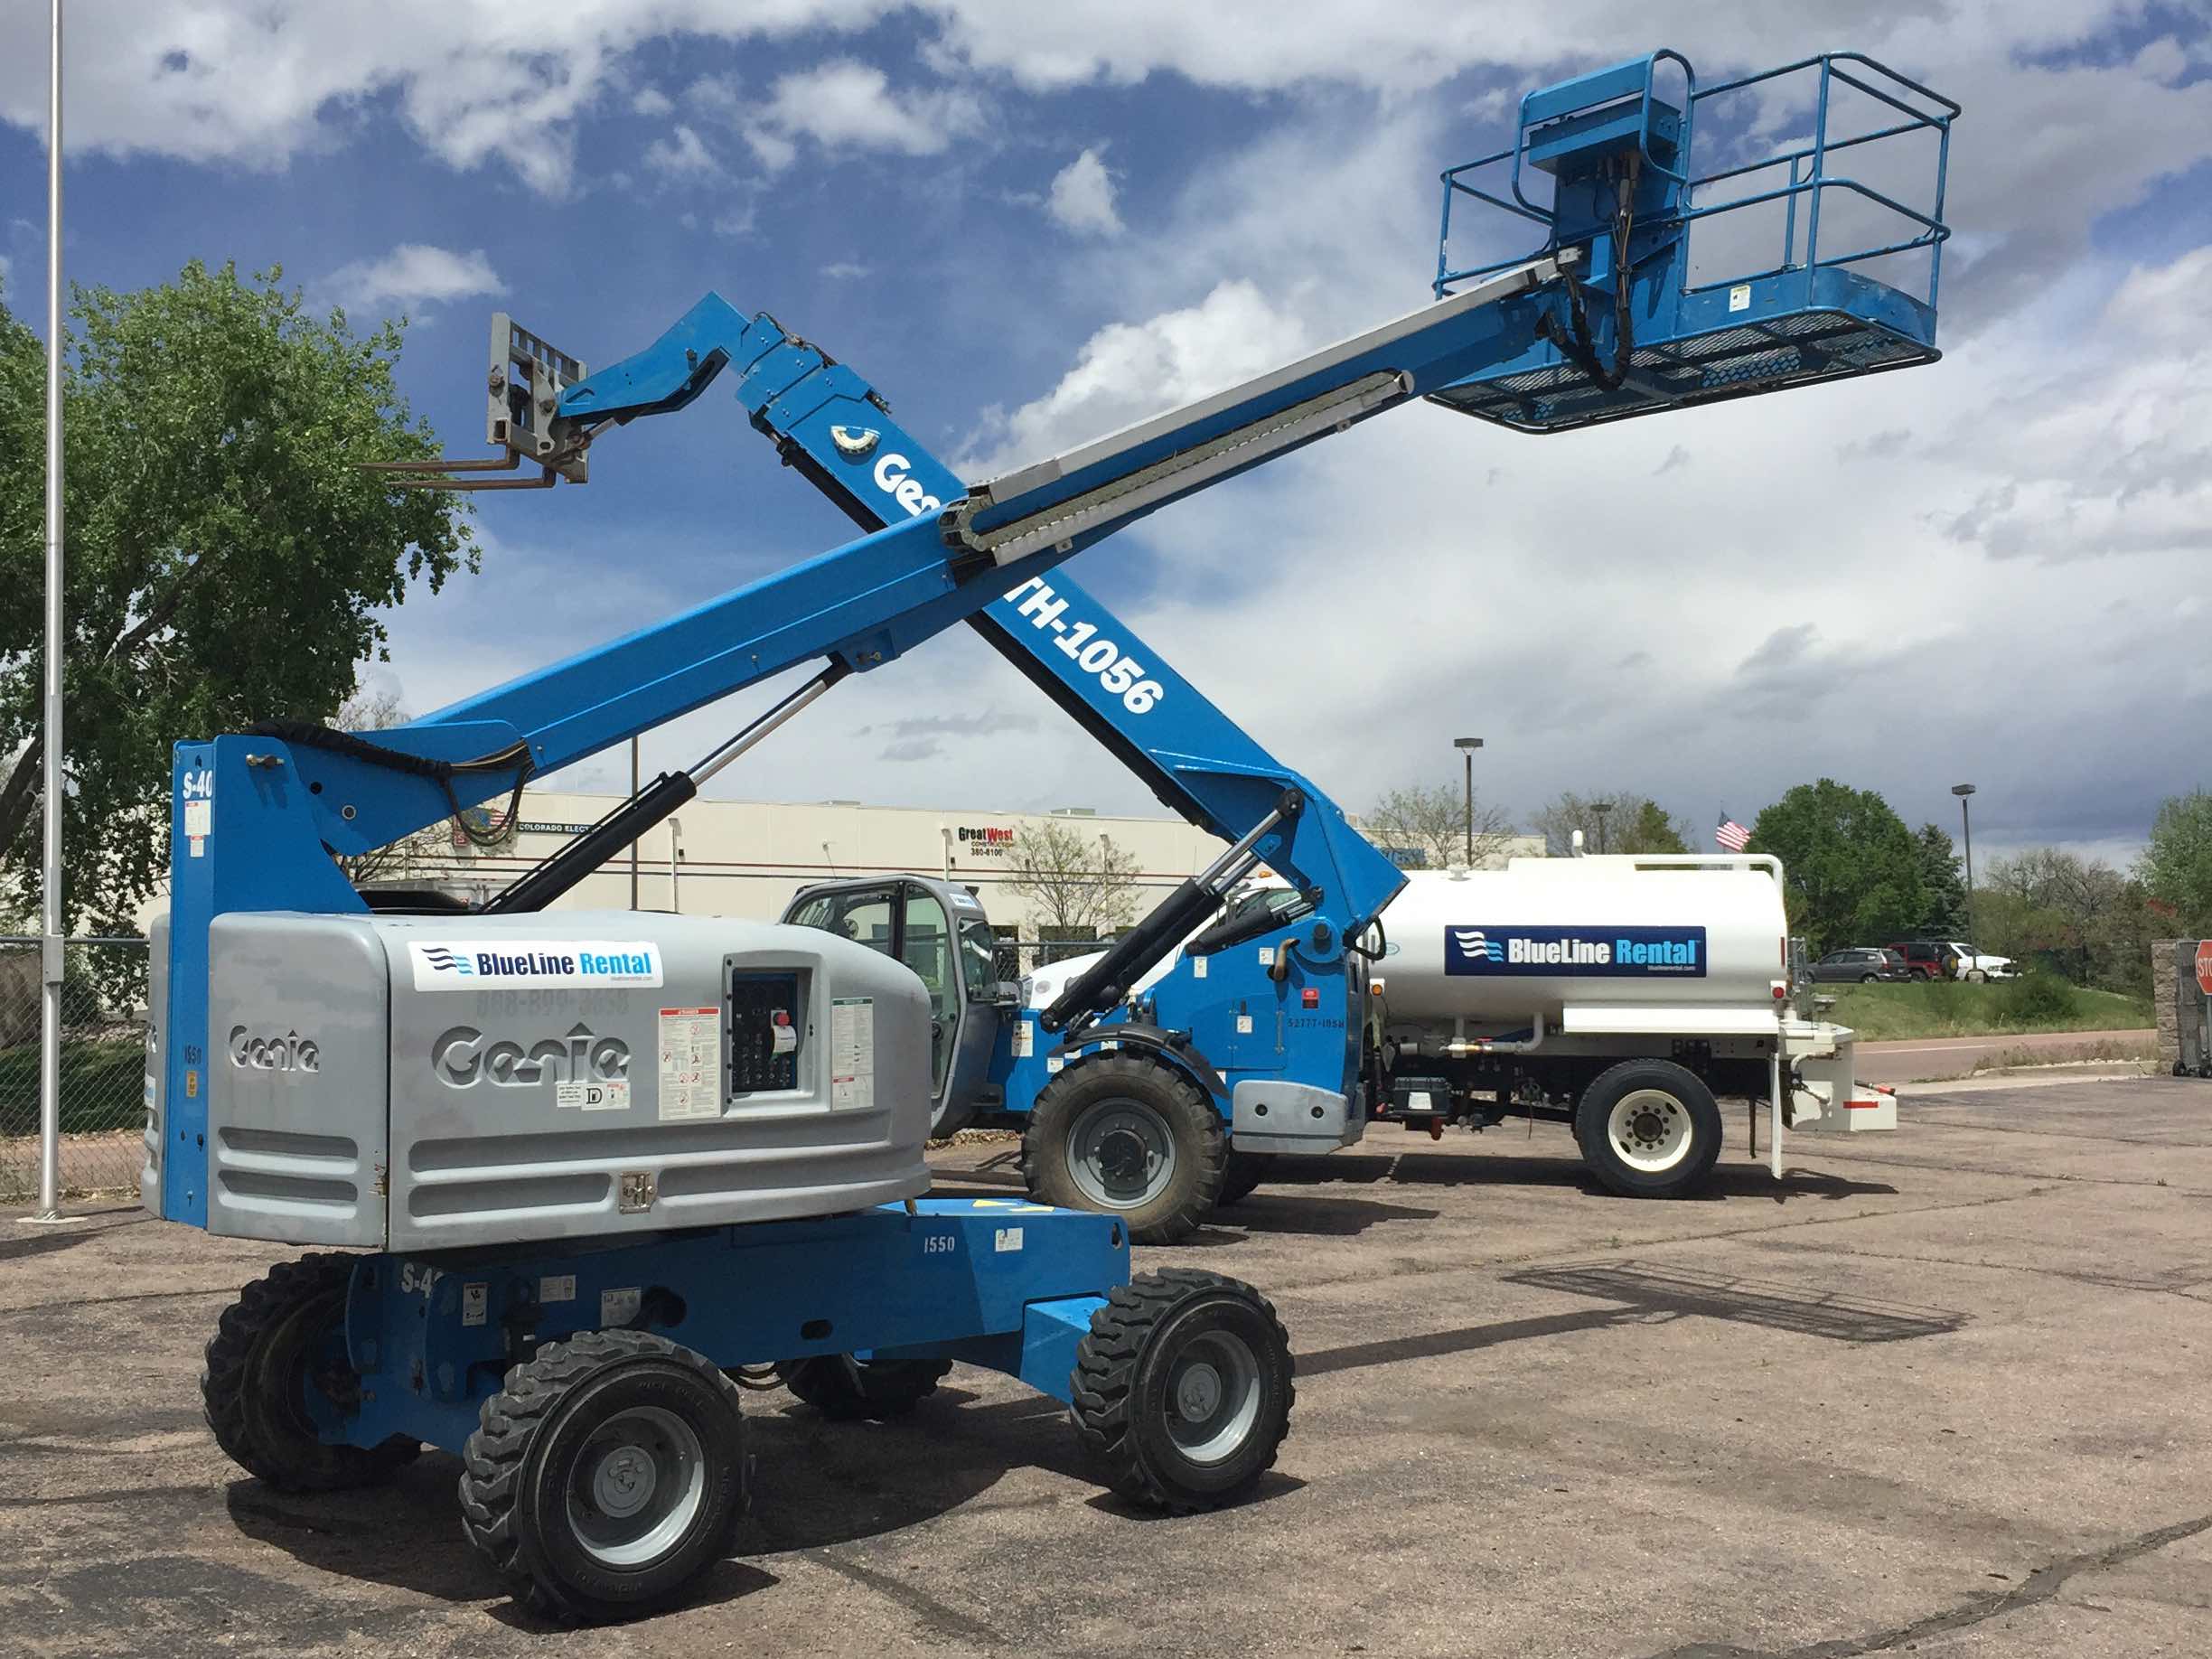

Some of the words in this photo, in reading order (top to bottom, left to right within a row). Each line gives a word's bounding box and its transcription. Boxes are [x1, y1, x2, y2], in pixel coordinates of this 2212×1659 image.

[1003, 576, 1164, 714] TH-1056
[183, 770, 212, 799] S-40
[519, 823, 563, 832] COLORADO
[958, 827, 1013, 842] GreatWest
[476, 952, 575, 976] BlueLine
[579, 952, 652, 975] Rental
[1508, 938, 1610, 964] BlueLine
[1616, 939, 1696, 964] Rental
[230, 1025, 320, 1073] Genie
[431, 1022, 632, 1090] Genie
[924, 1235, 955, 1253] 1550
[401, 1262, 445, 1298] S-4
